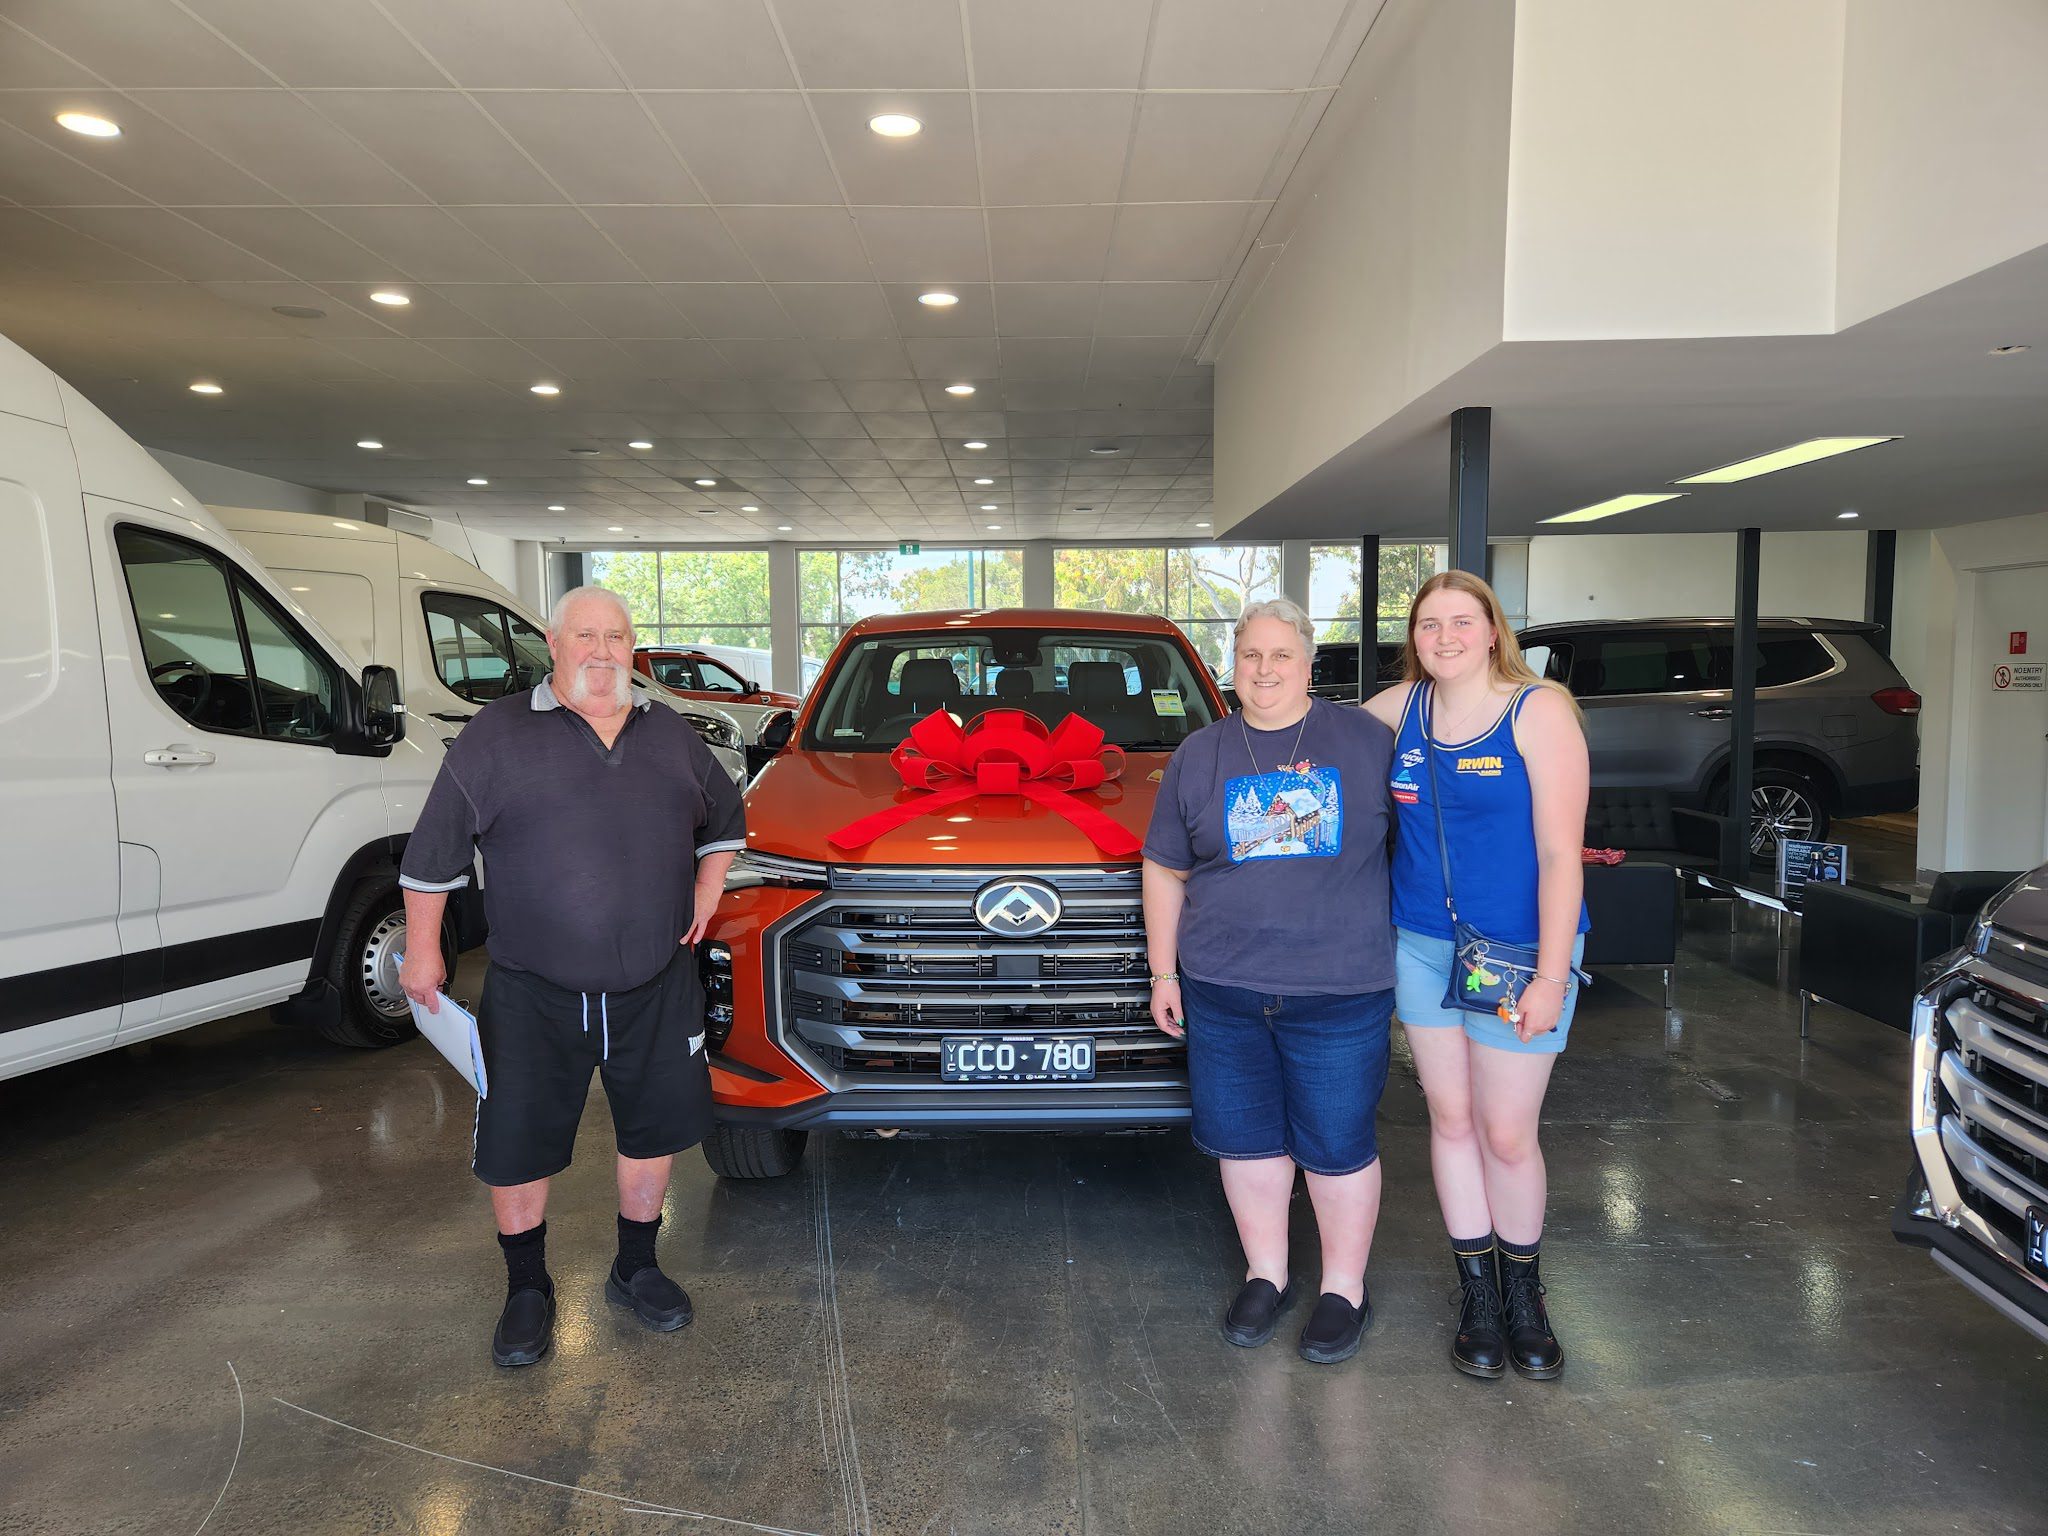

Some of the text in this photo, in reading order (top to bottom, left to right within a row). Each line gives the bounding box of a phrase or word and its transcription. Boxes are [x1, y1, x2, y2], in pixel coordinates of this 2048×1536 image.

[1400, 752, 1425, 763] FUCHS
[1457, 756, 1502, 770] IRWIN
[958, 1043, 1090, 1071] CCO 780
